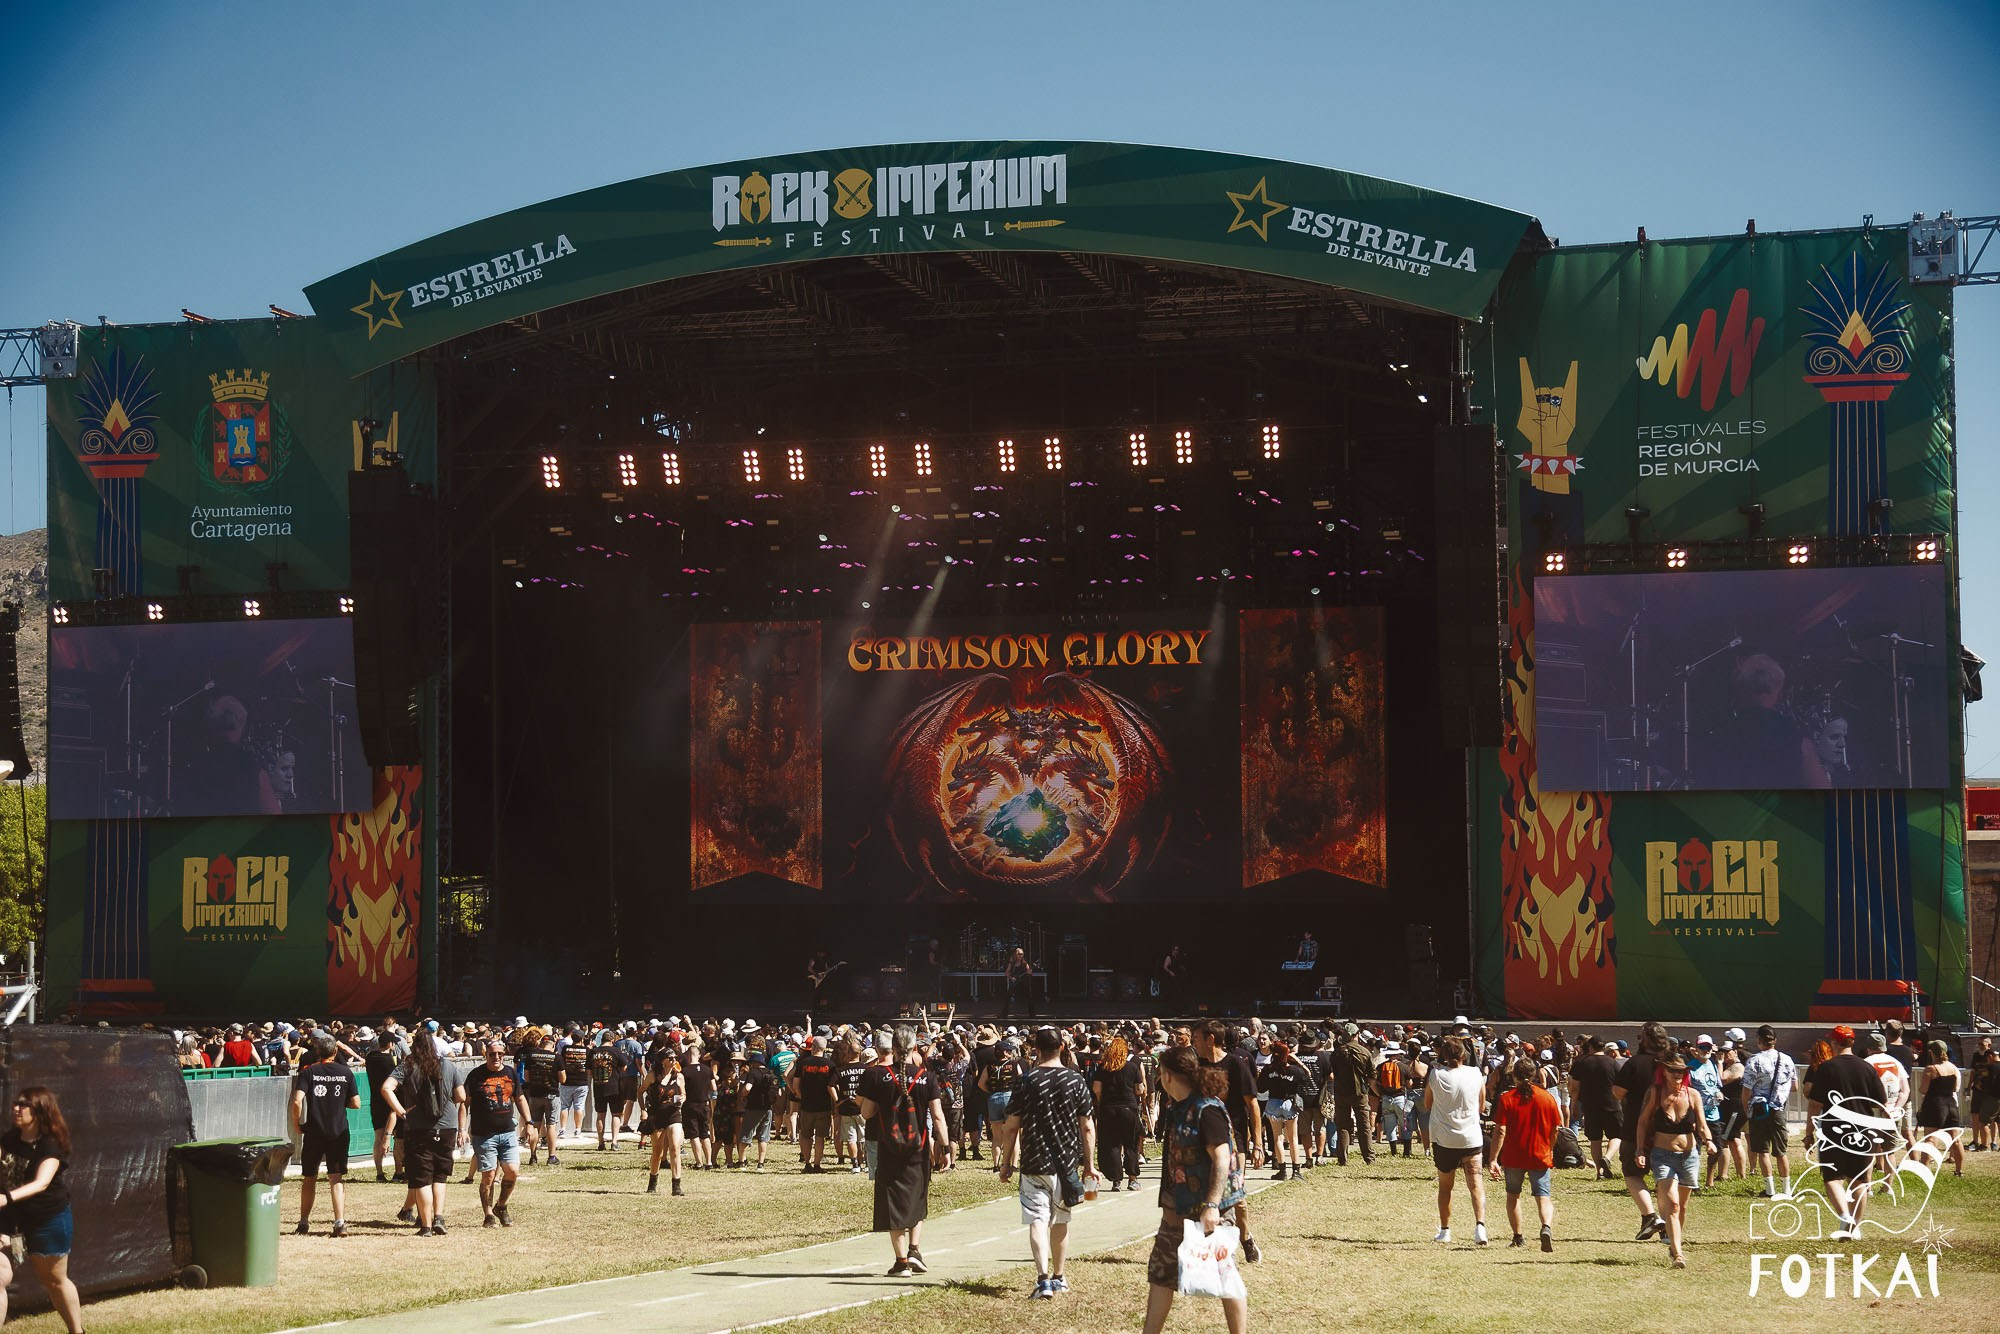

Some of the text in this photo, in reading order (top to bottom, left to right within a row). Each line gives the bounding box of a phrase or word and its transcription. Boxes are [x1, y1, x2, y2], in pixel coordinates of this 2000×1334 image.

[712, 154, 1067, 232] ROCK IMPERIUM
[785, 221, 995, 248] FESTIVAL
[1287, 207, 1477, 272] ESTRELLA
[407, 234, 577, 307] ESTRELLA
[1326, 242, 1431, 277] DE LEVANTE
[451, 268, 543, 307] DE LEVANTE
[1637, 420, 1767, 440] FESTIVALES
[1638, 439, 1721, 458] REGIÓN
[1639, 458, 1760, 477] DE MURCIA
[191, 504, 292, 520] Ayuntamiento
[190, 520, 293, 541] Cartagena
[847, 629, 1212, 676] CRIMSON GLORY
[182, 854, 289, 933] ROCK
[1645, 839, 1780, 927] ROCK
[195, 903, 275, 927] IMPERIUM
[1663, 894, 1763, 920] IMPERIUM
[203, 933, 268, 941] FESTIVAL
[1674, 927, 1756, 936] FESTIVAL
